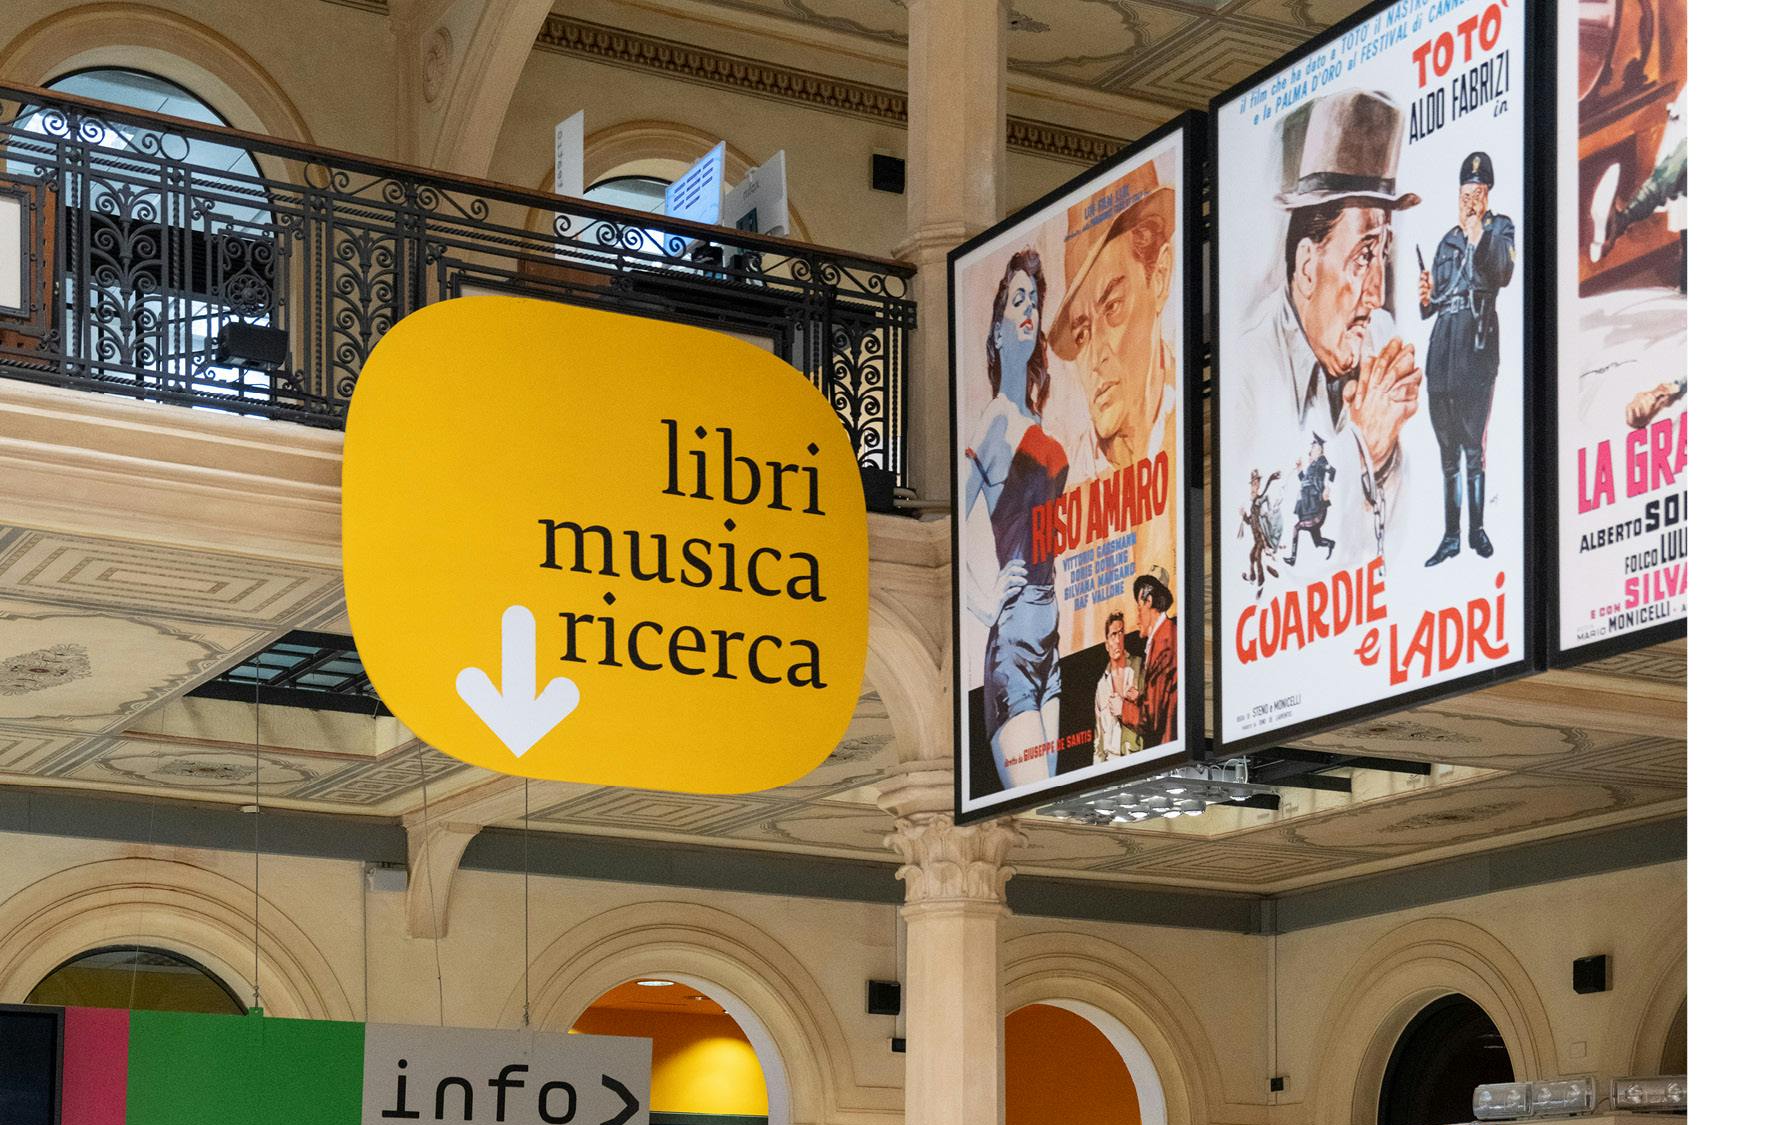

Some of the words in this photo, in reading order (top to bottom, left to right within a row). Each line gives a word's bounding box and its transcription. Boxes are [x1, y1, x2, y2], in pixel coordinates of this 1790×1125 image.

[1253, 114, 1260, 125] e
[1263, 105, 1272, 120] la
[1275, 80, 1308, 113] PALMA
[1311, 60, 1342, 92] D'ORO
[1347, 51, 1357, 71] al
[1361, 21, 1408, 63] FESTIVAL
[1411, 12, 1423, 33] di
[1271, 75, 1287, 95] che
[1291, 67, 1302, 84] ha
[1306, 55, 1326, 75] dato
[1409, 87, 1445, 145] ALDO
[1451, 49, 1510, 121] FABRIZI
[1493, 99, 1509, 117] in
[660, 418, 827, 517] libri
[1577, 439, 1616, 515] LA
[1032, 486, 1082, 566] RISO
[1086, 450, 1169, 545] AMARO
[1579, 517, 1643, 554] ALBERTO
[1645, 490, 1687, 533] SO
[538, 517, 828, 605] musica
[1624, 548, 1659, 575] FOLCO
[559, 592, 828, 690] ricerca
[1235, 556, 1388, 665] GUARDIE
[1576, 626, 1607, 641] MARIO
[1608, 600, 1671, 634] MONICELLI
[1590, 608, 1596, 620] E
[1599, 602, 1622, 617] CON
[1354, 627, 1381, 667] e
[1023, 740, 1055, 762] GIUSEPPE
[1056, 737, 1065, 752] DE
[1066, 729, 1093, 749] SANTIS
